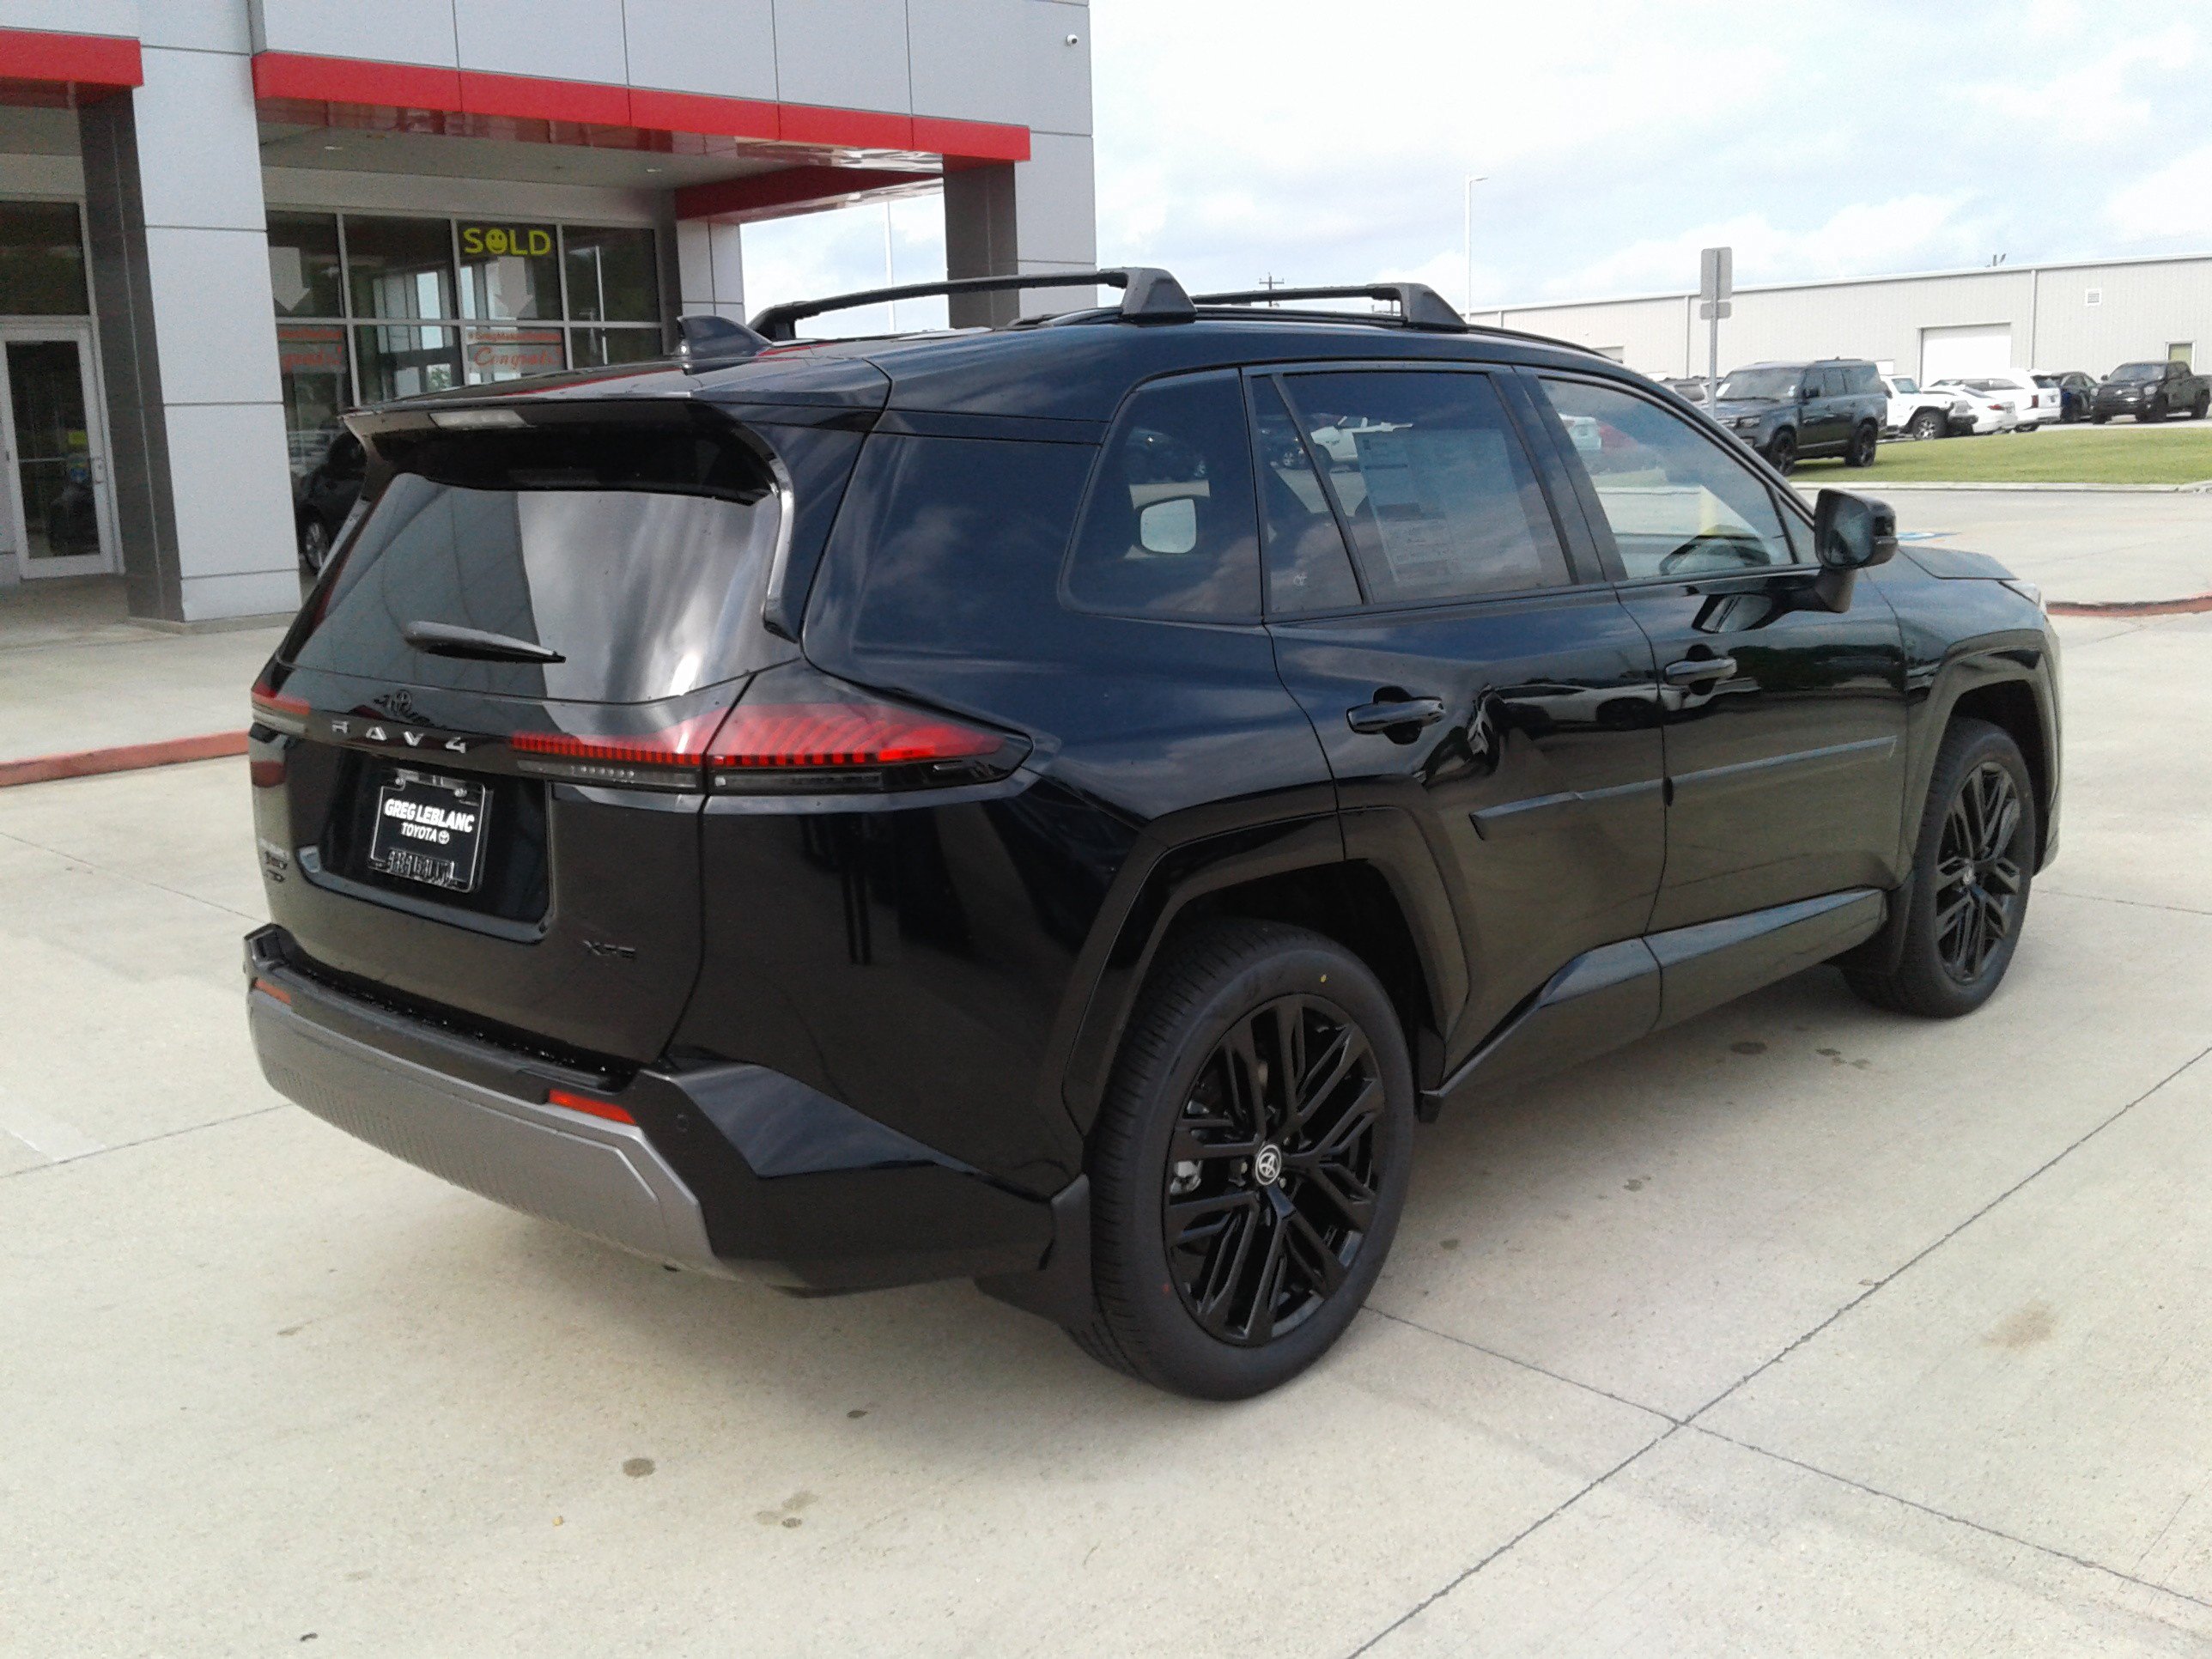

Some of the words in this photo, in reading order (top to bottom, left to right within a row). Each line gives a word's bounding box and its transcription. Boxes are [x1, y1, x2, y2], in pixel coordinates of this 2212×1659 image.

[464, 228, 550, 255] SOLD
[331, 720, 466, 754] RAV4
[384, 798, 416, 820] GREG
[415, 805, 475, 833] LEBLANC
[401, 823, 437, 843] TOYOTA
